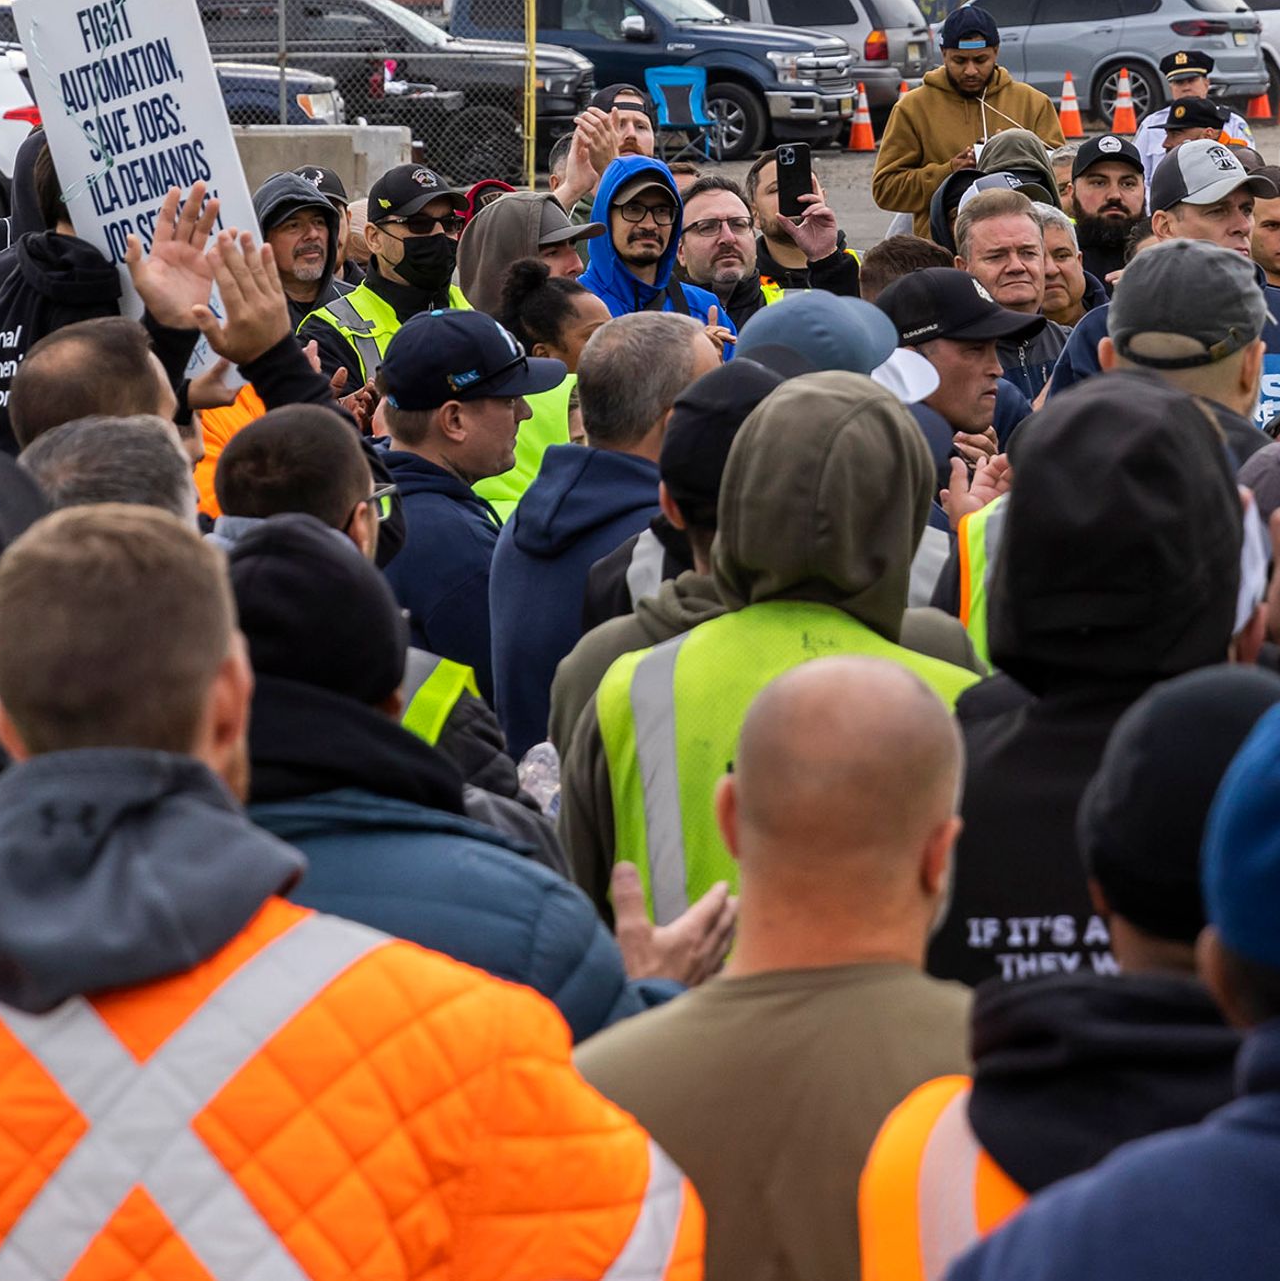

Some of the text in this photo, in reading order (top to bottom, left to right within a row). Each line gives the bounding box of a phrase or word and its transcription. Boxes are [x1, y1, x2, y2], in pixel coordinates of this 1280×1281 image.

[59, 37, 184, 116] AUTOMATION,
[83, 93, 187, 162] SAVE JOBS:
[86, 139, 212, 217] ILA DEMANDS
[967, 917, 1001, 948] IF
[1006, 915, 1077, 948] IT'S
